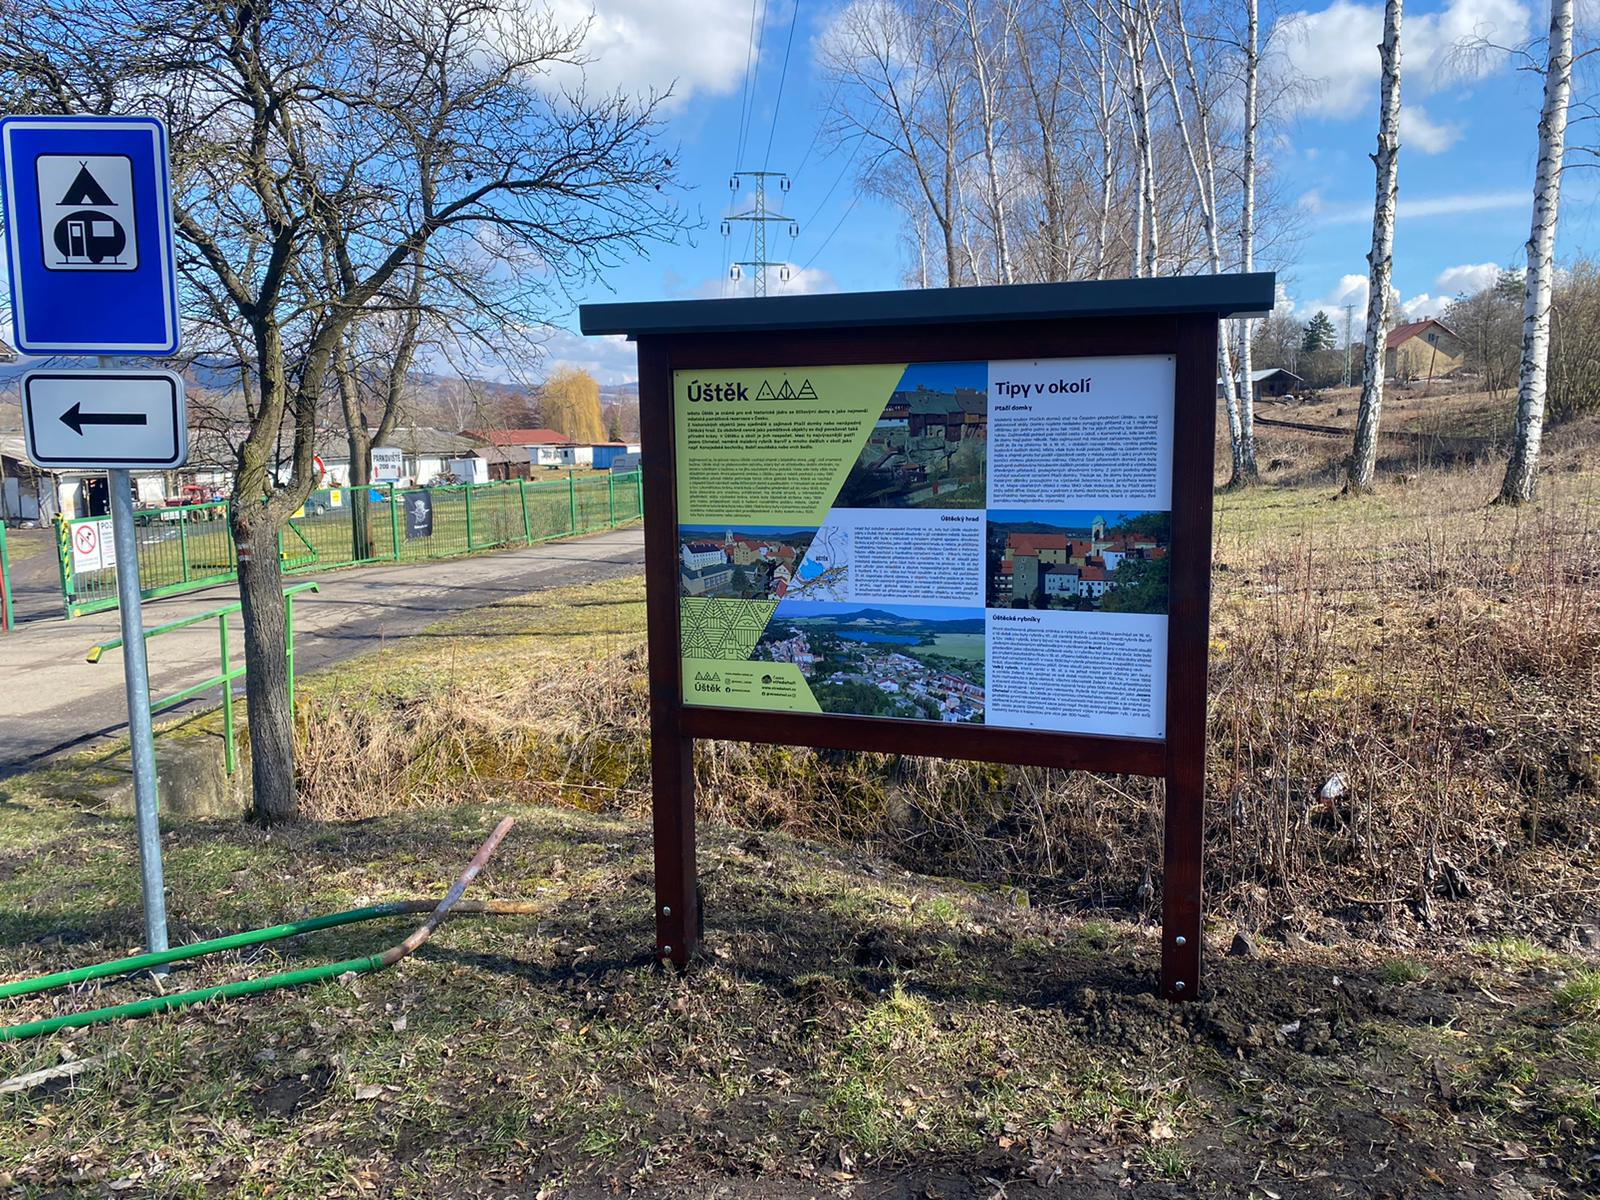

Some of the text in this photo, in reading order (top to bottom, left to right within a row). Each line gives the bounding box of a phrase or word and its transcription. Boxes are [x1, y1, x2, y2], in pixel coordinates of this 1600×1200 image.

[688, 380, 748, 402] Úštěk
[995, 378, 1090, 398] Tipy v okolí
[373, 452, 400, 462] PARKOVIŠTĚ
[694, 682, 720, 693] Úštěk
